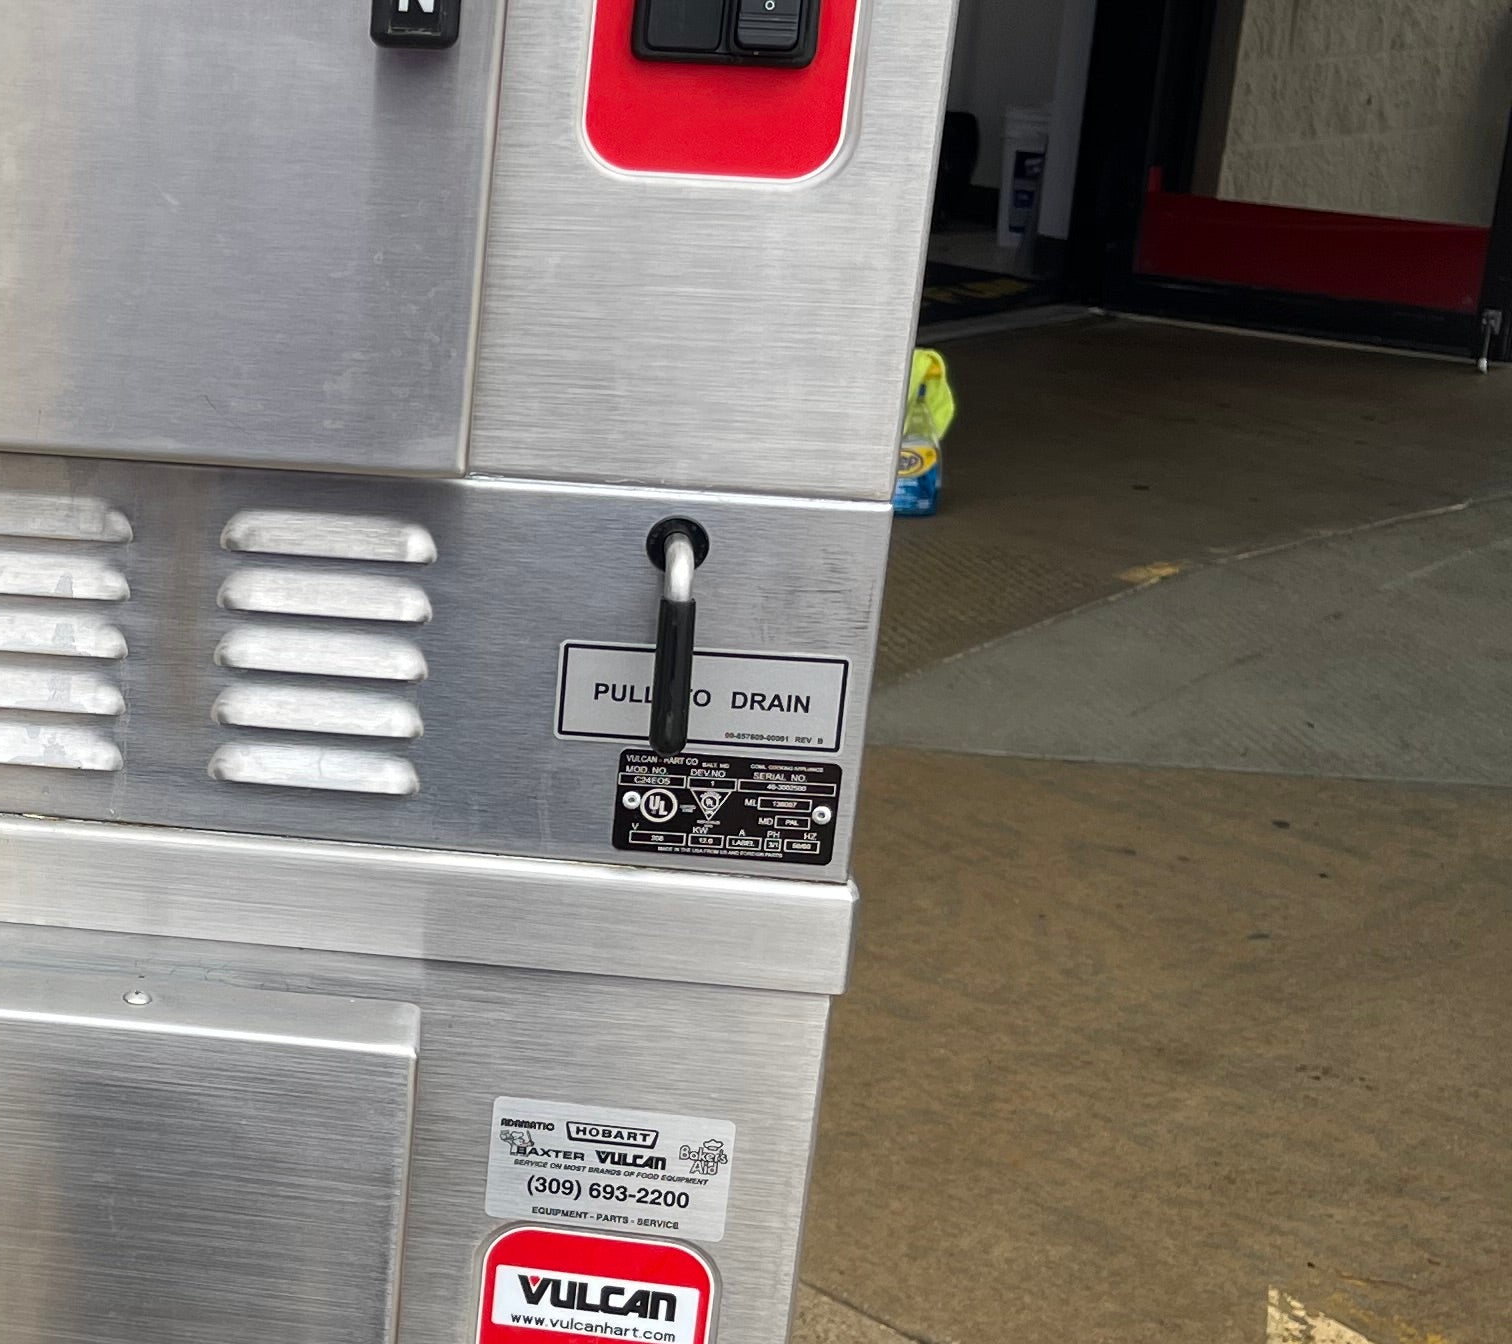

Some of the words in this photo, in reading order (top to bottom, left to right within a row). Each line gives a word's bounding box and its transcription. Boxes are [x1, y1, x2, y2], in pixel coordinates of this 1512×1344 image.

[689, 688, 712, 708] O
[731, 691, 811, 714] DRAIN
[795, 736, 812, 745] REV
[626, 754, 658, 763] VULCAN
[685, 758, 698, 766] CO
[625, 765, 650, 774] MOD.
[753, 772, 786, 781] SERIAL
[631, 822, 639, 830] V
[692, 826, 709, 834] KW
[738, 829, 746, 837] A
[767, 830, 780, 838] PH
[575, 1126, 651, 1143] HOBART
[517, 1146, 585, 1161] BAXTER
[595, 1150, 666, 1170] VULCAN
[514, 1159, 548, 1169] SERVICE
[564, 1164, 587, 1172] MOST
[588, 1167, 622, 1176] BRANDS
[623, 1170, 635, 1178] OF
[636, 1172, 659, 1181] FOOD
[661, 1174, 708, 1186] EQUIPMENT
[689, 1161, 718, 1175] Aid
[527, 1175, 582, 1200] (309)
[588, 1183, 690, 1209] 693-2200
[532, 1206, 588, 1220] EQUIPMENT
[596, 1213, 629, 1224] PARTS
[637, 1217, 679, 1229] SERVICE
[518, 1274, 677, 1322] VULCAN
[511, 1312, 676, 1343] www.vulcanhart.com
